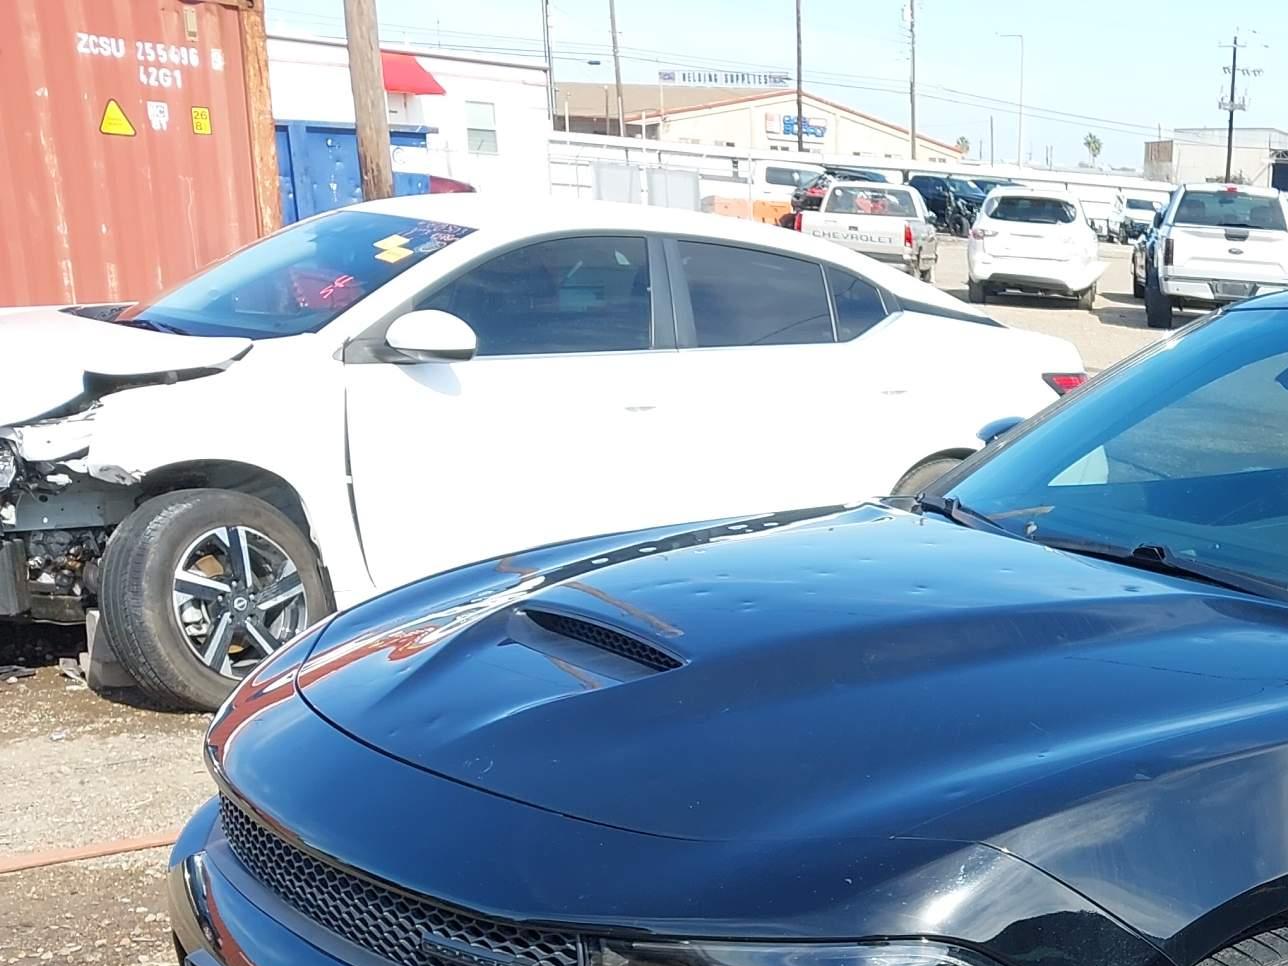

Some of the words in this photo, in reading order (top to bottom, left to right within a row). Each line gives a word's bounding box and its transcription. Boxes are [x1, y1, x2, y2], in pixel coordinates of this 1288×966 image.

[76, 32, 126, 59] ZCSU
[138, 65, 182, 89] 42G1
[812, 230, 893, 244] CHEVROLET
